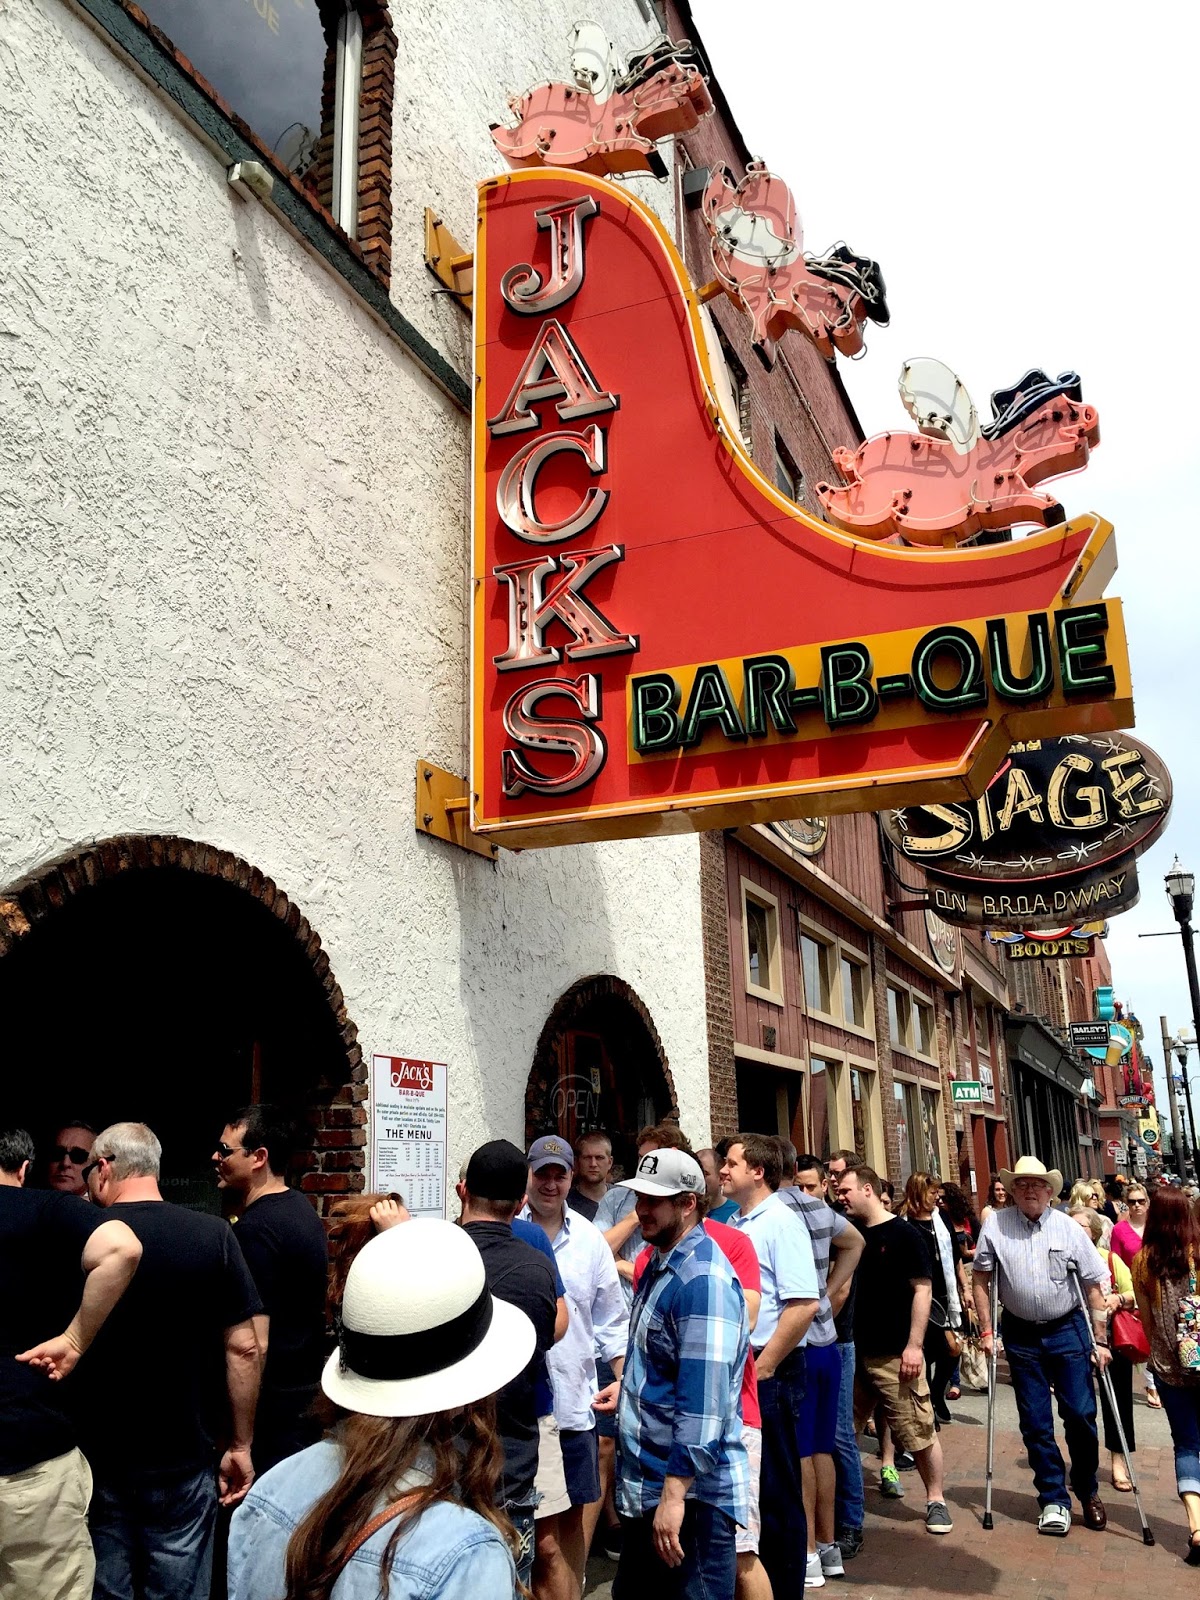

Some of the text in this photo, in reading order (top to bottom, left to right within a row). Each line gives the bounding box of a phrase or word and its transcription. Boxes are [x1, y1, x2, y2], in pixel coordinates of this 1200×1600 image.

[486, 193, 638, 798] JACKS
[631, 602, 1117, 753] BAR-B-QUE
[935, 874, 1127, 914] ON BROADWAY
[1009, 938, 1089, 958] BOOTS
[1072, 1026, 1106, 1034] BAILEY'S
[391, 1061, 433, 1089] JACK'S
[552, 1088, 600, 1118] OPEN
[955, 1087, 979, 1098] ATM
[386, 1129, 432, 1140] THE MENU
